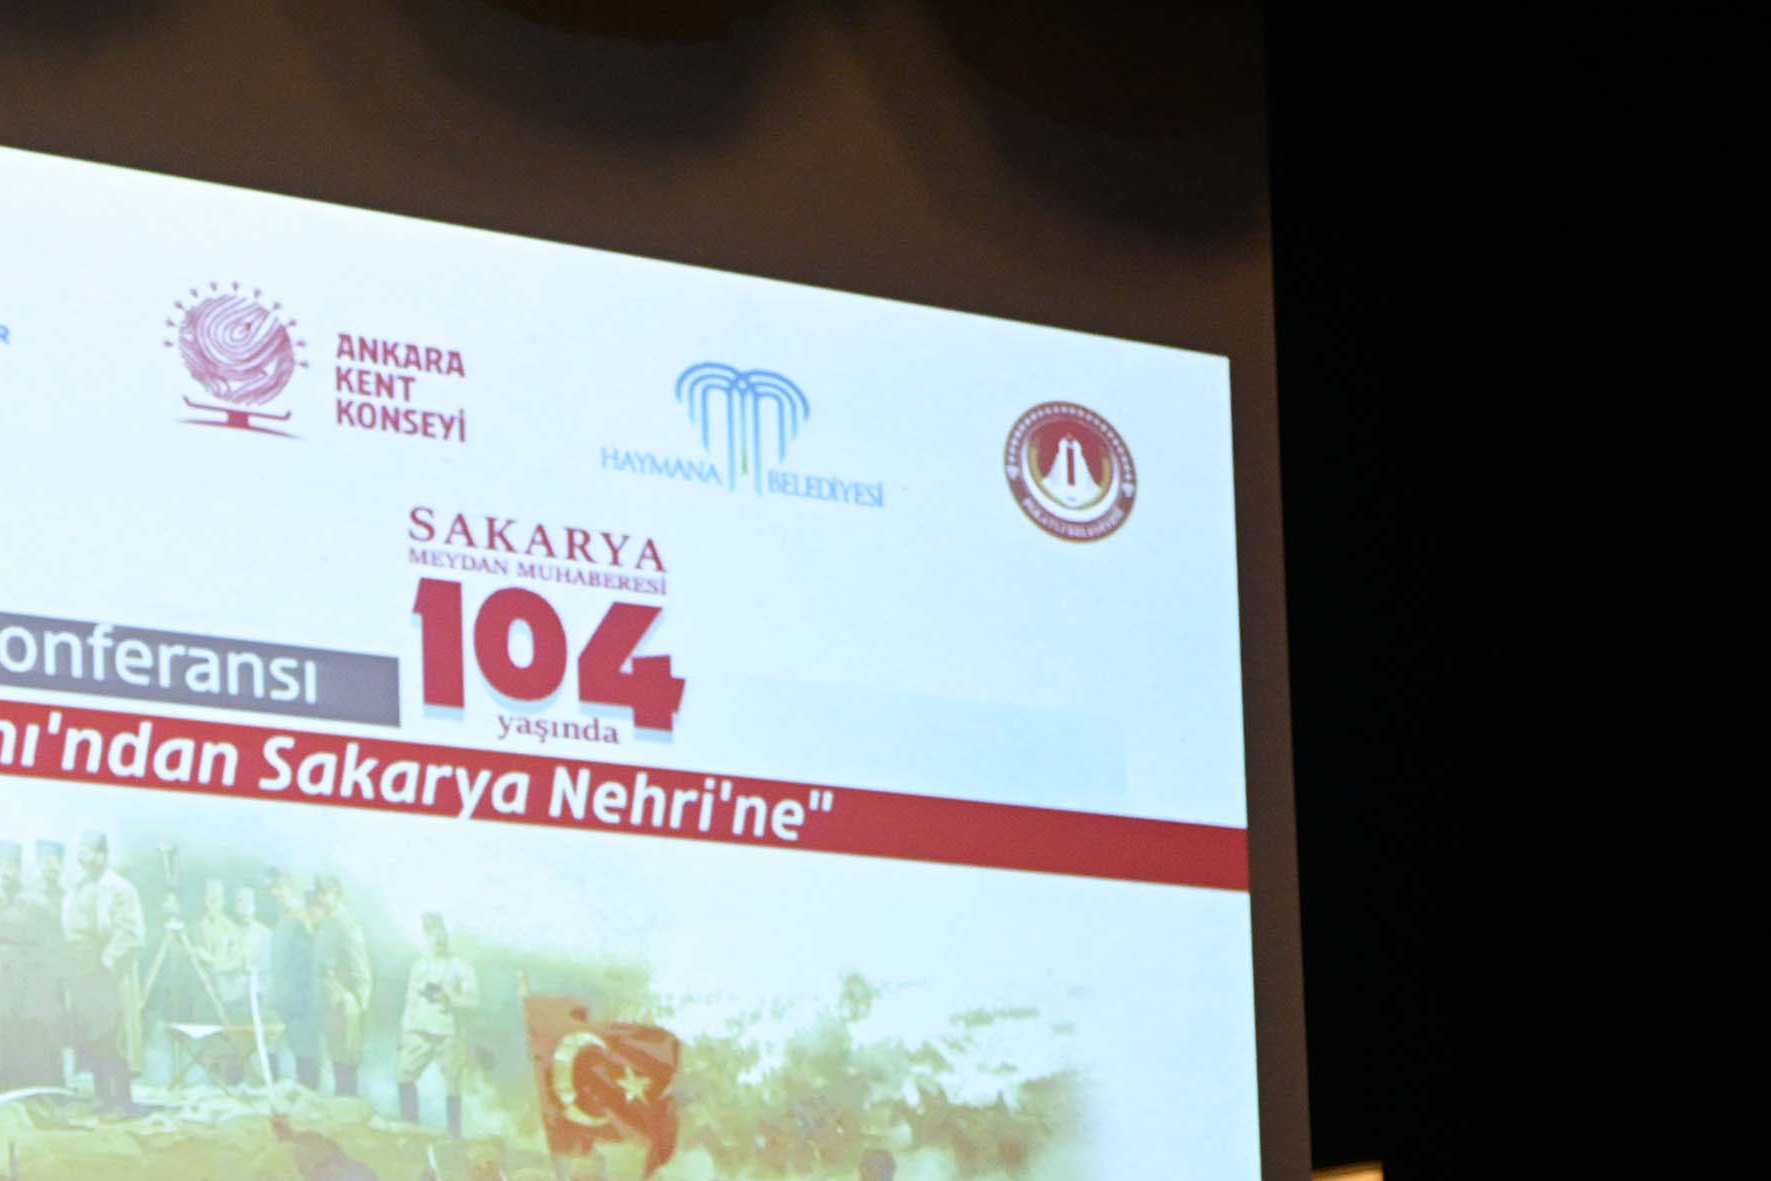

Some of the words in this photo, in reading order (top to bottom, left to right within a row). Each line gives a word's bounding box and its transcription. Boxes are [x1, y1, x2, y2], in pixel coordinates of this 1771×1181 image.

[336, 333, 466, 377] ANKARA
[336, 366, 416, 402] KENT
[336, 399, 467, 443] KONSEYİ
[600, 446, 723, 486] HAYMANA
[768, 470, 885, 508] BELEDİYESİ
[408, 506, 666, 573] SAKARYA
[409, 548, 508, 575] MEYDAN
[517, 562, 667, 596] MUHABERESİ
[412, 577, 686, 732] 104
[497, 714, 619, 744] yaşında
[259, 736, 530, 820] Sakarya
[548, 766, 835, 841] Nehri'ne"
